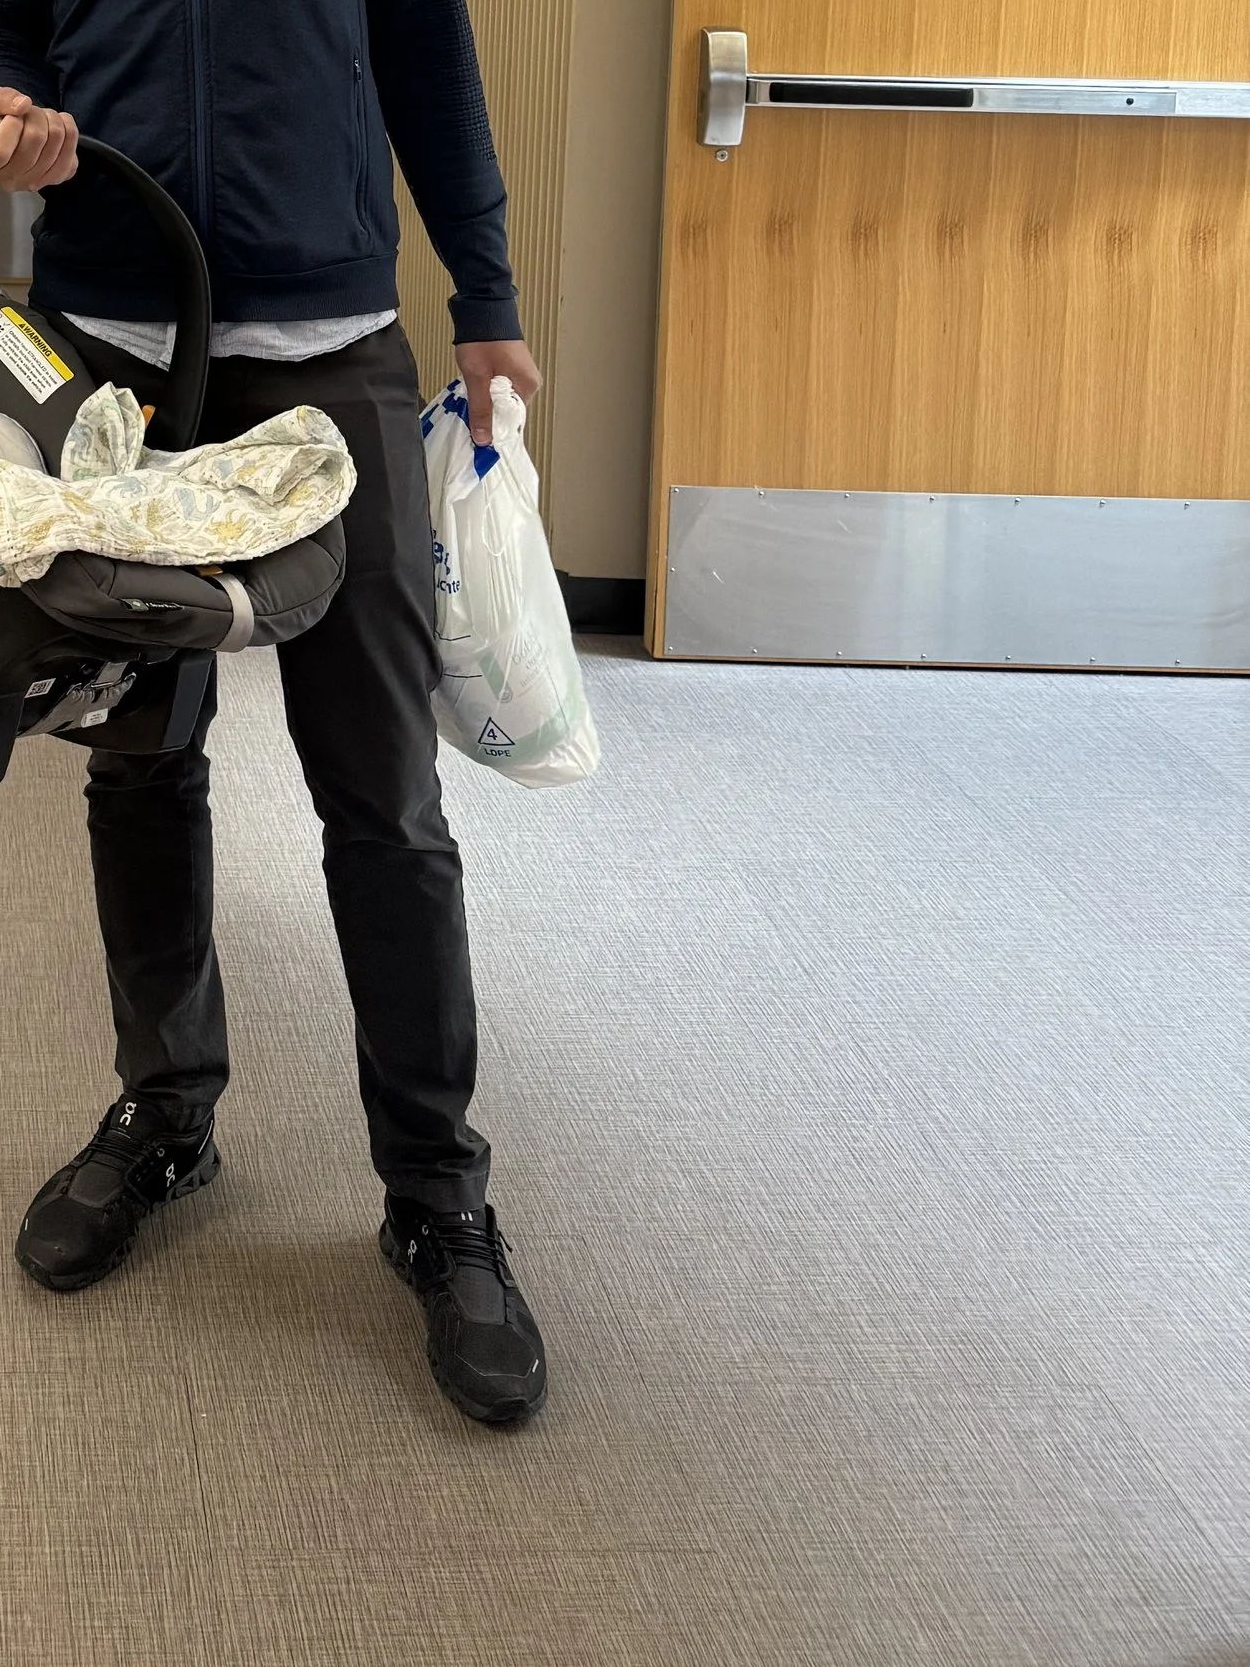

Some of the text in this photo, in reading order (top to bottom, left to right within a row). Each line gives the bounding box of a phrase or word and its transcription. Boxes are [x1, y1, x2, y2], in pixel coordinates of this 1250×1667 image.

[23, 325, 53, 358] WARNING
[487, 728, 498, 740] 4
[483, 747, 511, 758] LDPE
